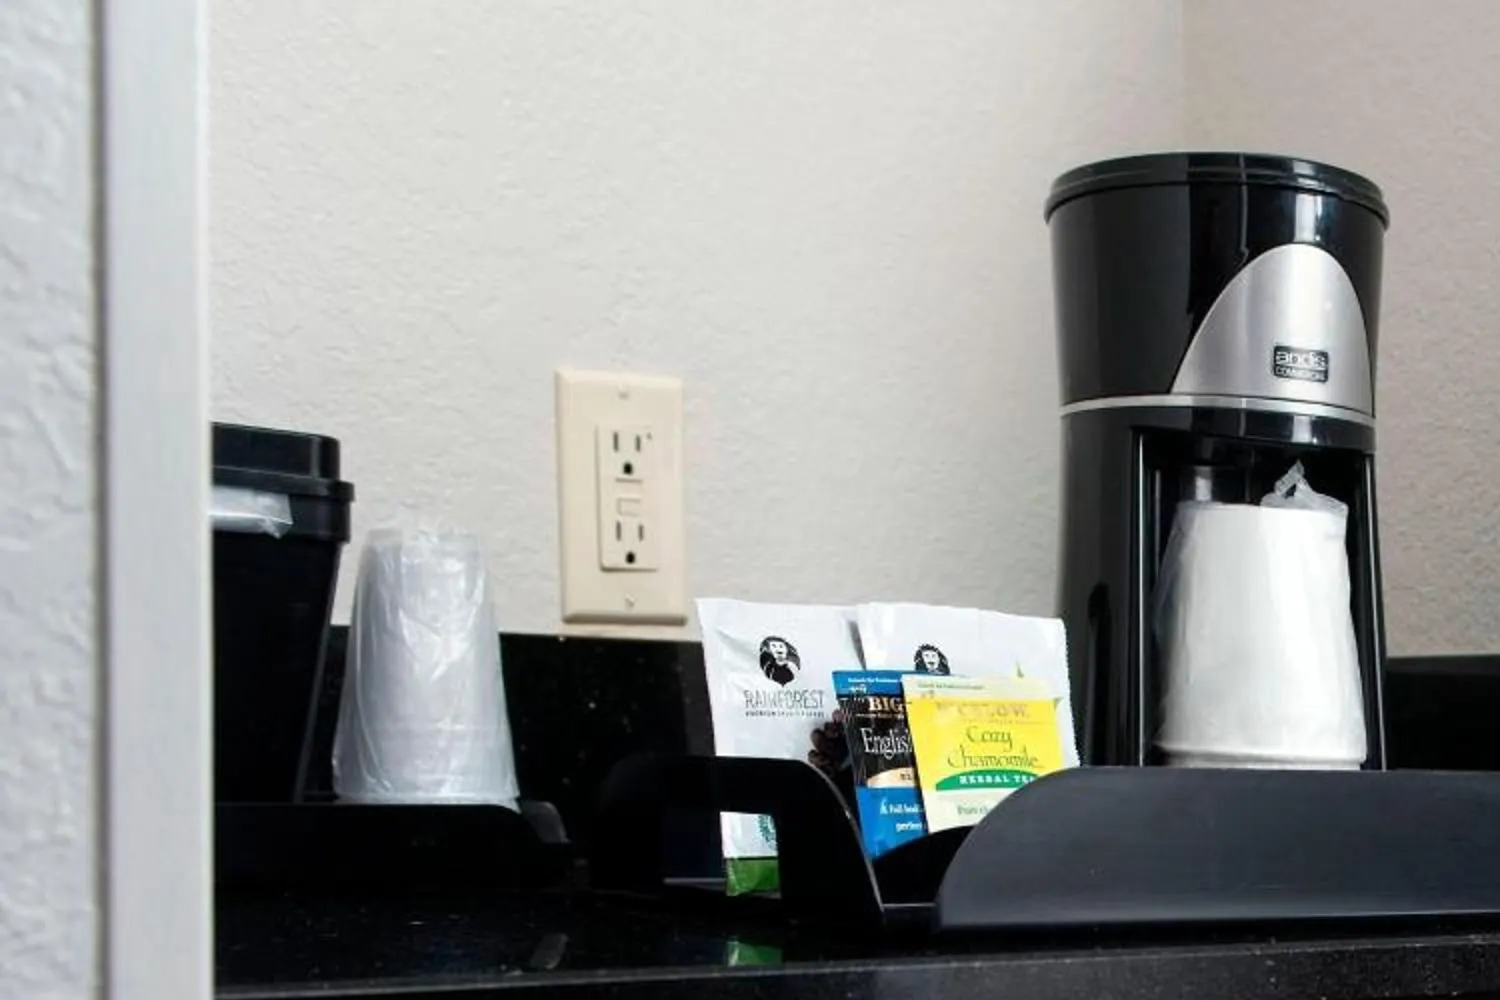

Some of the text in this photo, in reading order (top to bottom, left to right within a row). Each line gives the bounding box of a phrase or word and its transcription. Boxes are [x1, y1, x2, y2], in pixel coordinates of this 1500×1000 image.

[743, 689, 824, 709] RAINFOREST
[966, 725, 1012, 752] Cozy
[947, 744, 1045, 769] Chamomile
[959, 775, 1010, 785] HERBAL
